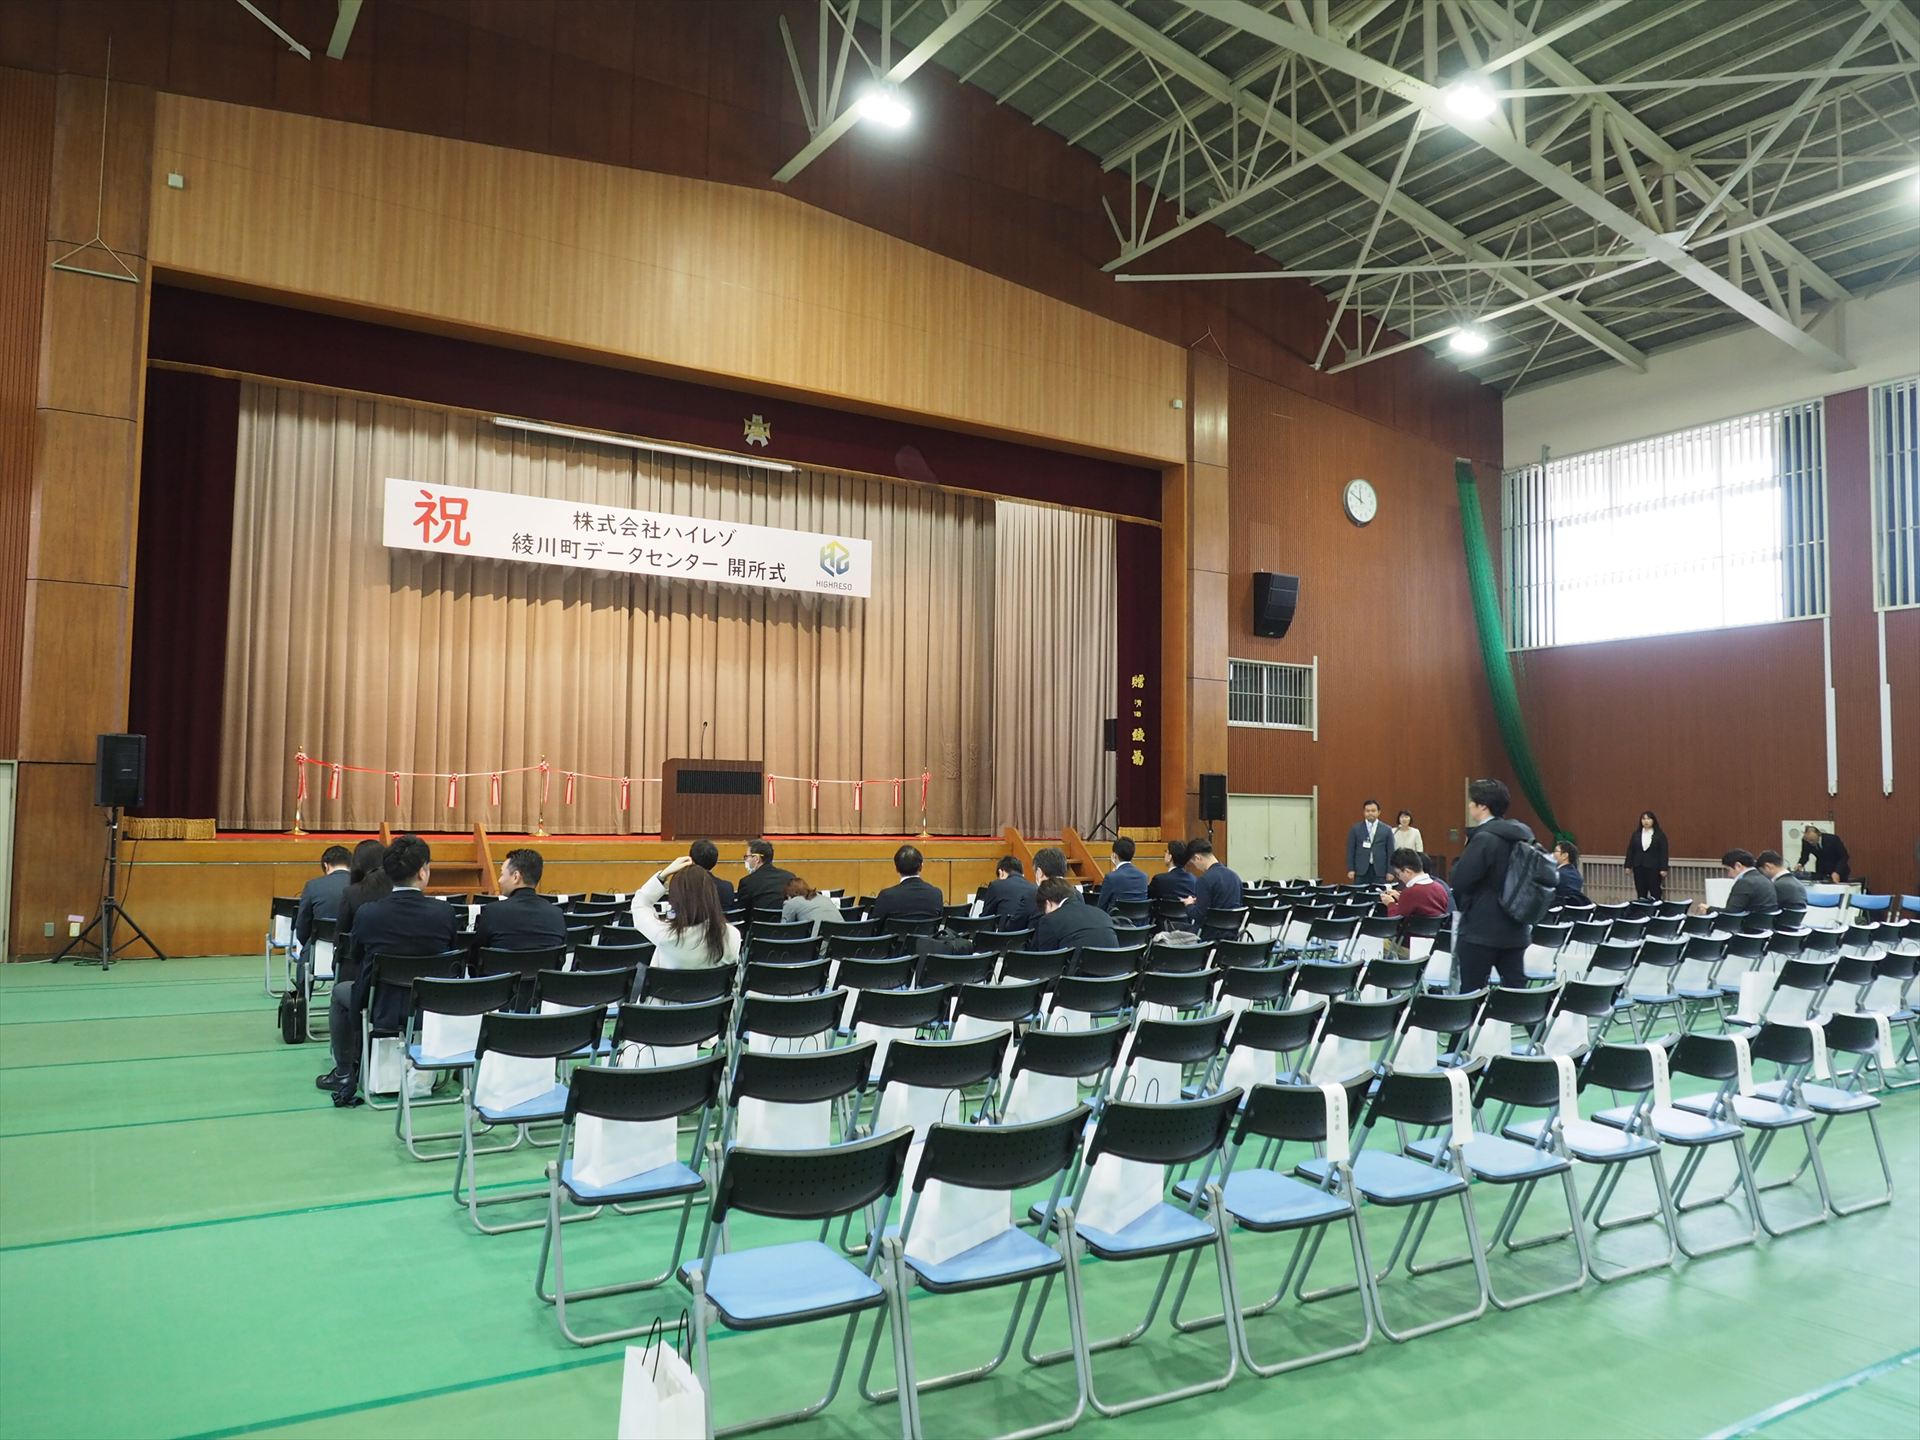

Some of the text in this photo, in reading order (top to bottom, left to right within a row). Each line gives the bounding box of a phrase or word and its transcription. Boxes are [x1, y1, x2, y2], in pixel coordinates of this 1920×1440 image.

[412, 489, 471, 546] 祝
[573, 510, 737, 547] 株式会社ハイレゾ
[511, 532, 787, 582] 綾川町データセンター 開所式
[816, 580, 853, 591] HIGHRESO
